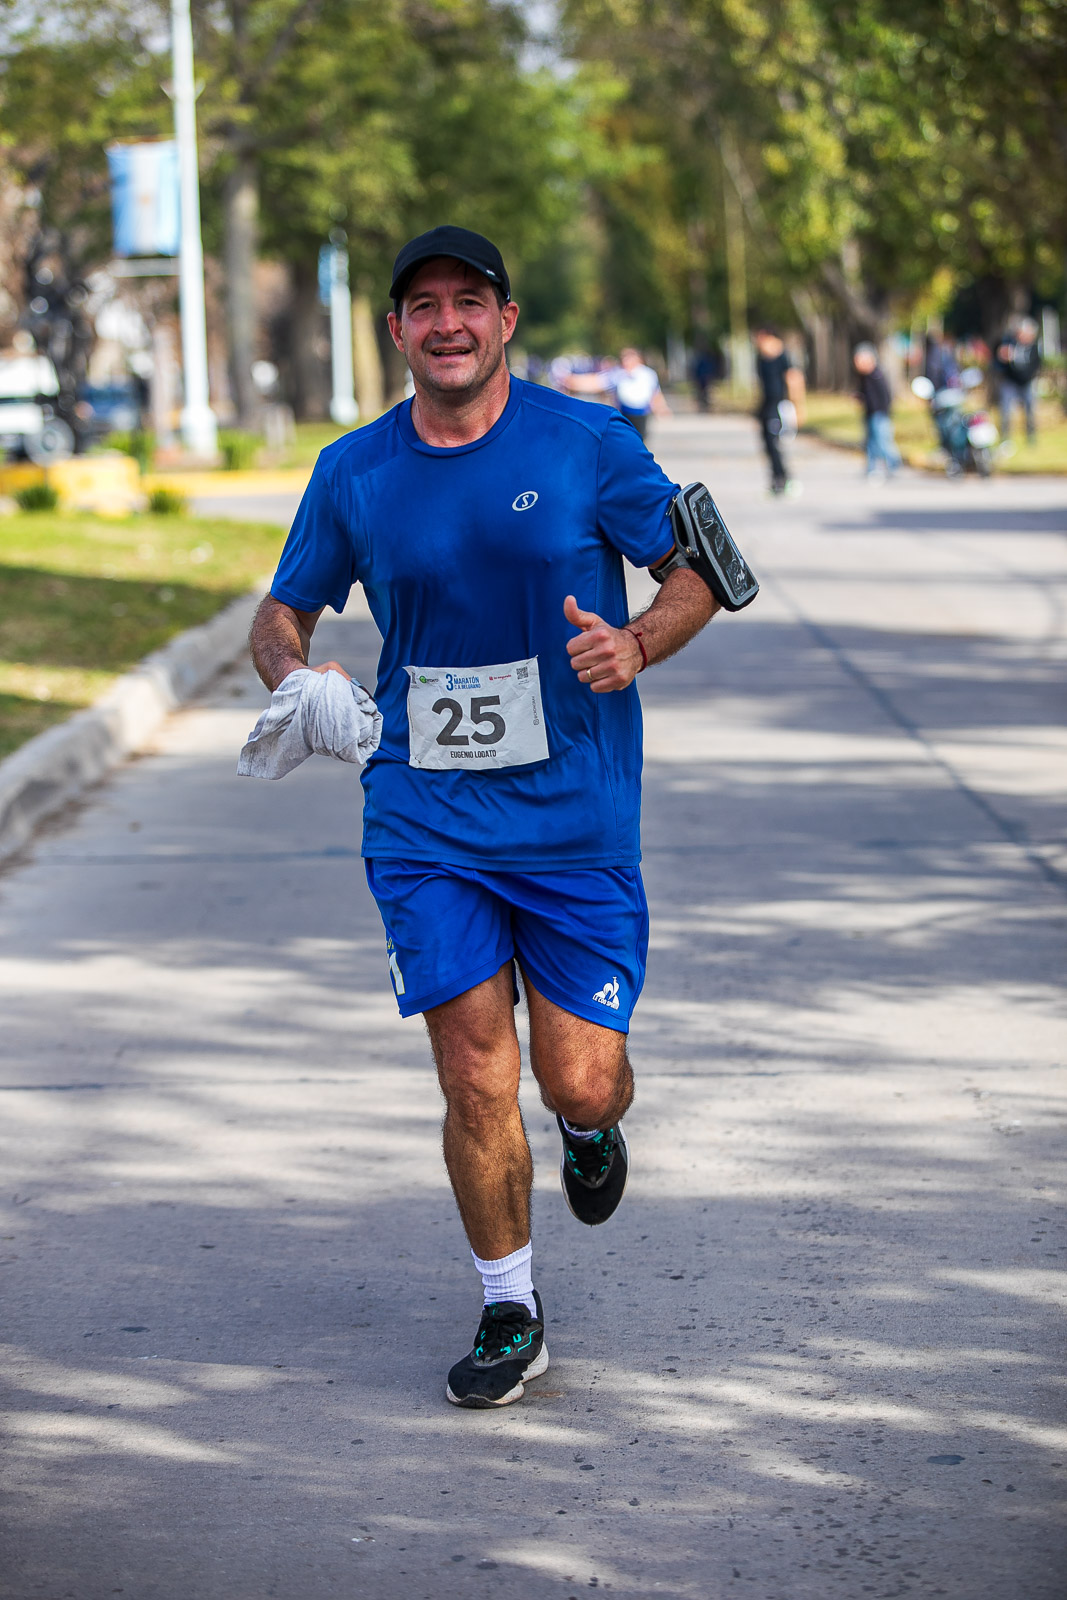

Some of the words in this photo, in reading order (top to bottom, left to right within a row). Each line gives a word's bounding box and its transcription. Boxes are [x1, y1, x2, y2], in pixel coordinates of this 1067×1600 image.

[445, 673, 454, 691] 3
[453, 676, 480, 685] MARATÓN
[432, 695, 506, 746] 25
[450, 750, 474, 759] EUGENIO
[474, 749, 497, 759] LODATO
